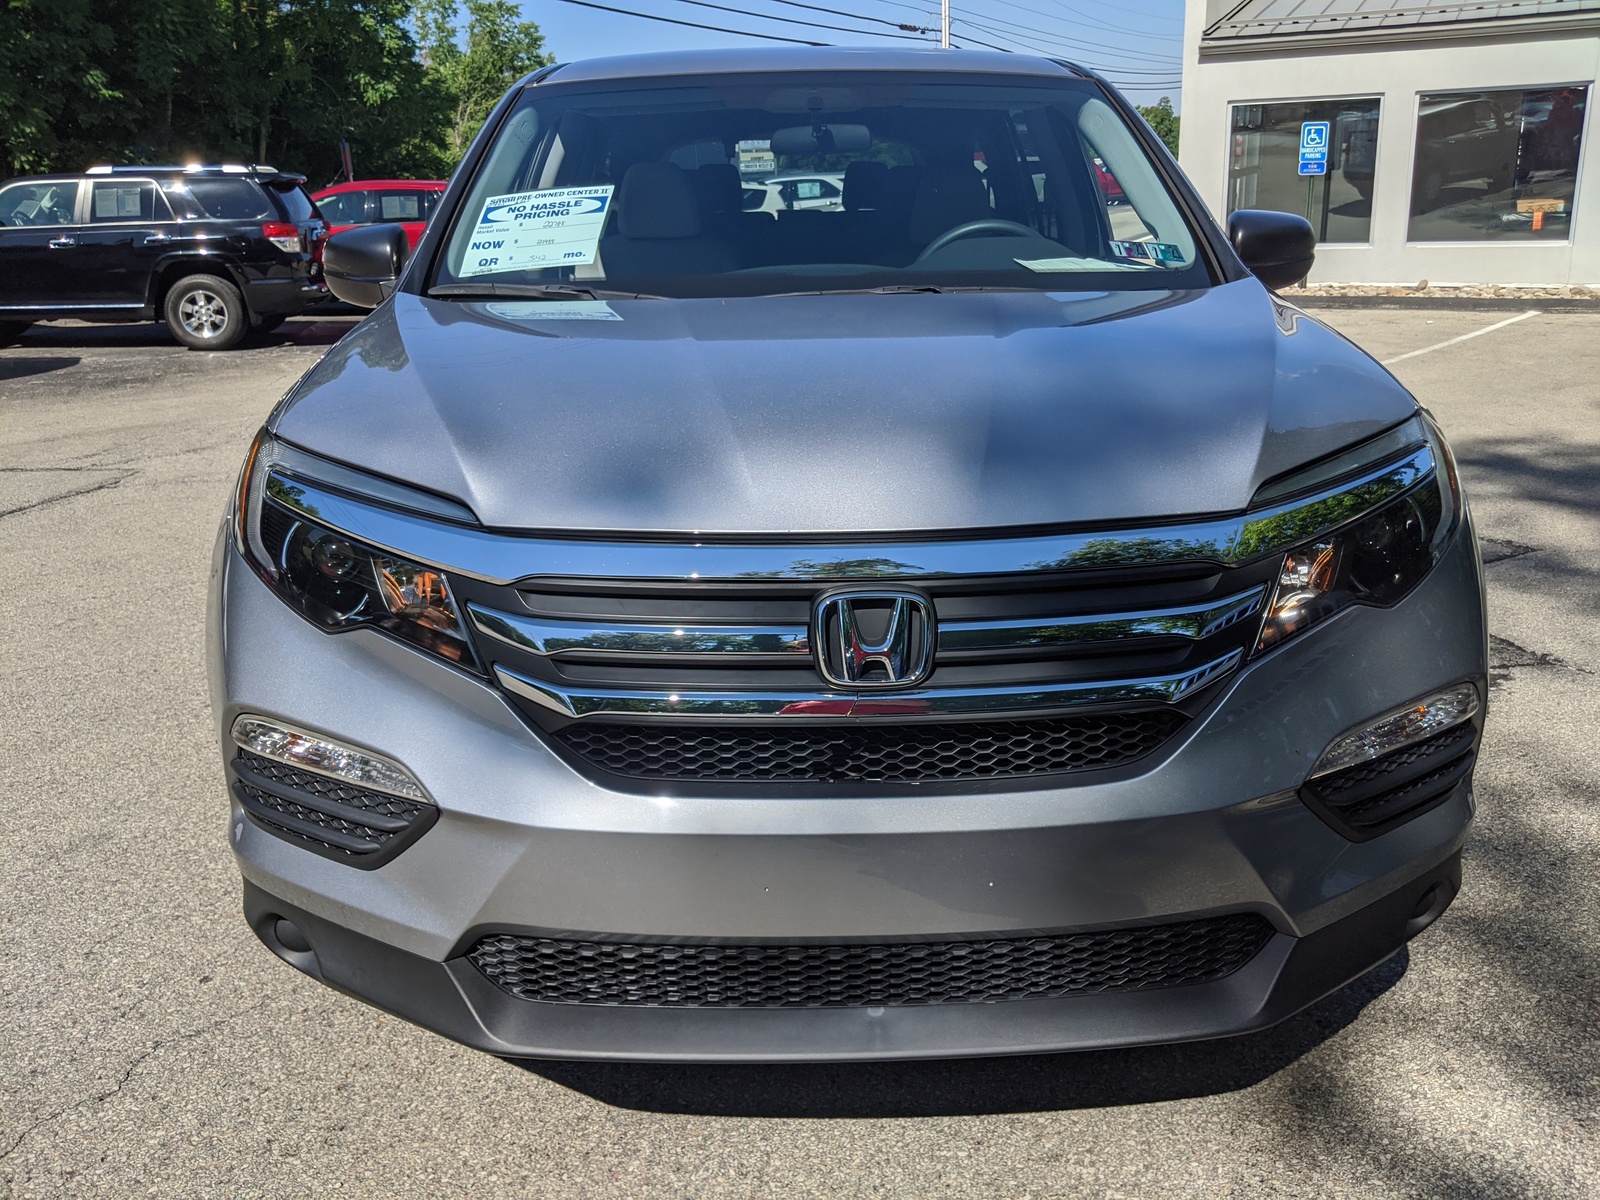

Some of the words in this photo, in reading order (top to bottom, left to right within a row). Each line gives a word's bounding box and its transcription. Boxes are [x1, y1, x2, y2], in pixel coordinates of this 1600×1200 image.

[516, 191, 565, 202] PRE-OWNED
[566, 189, 599, 197] CENTER
[507, 205, 526, 214] NO
[530, 199, 583, 211] HASSLE
[514, 208, 570, 220] PRICING
[471, 240, 505, 250] NOW
[562, 251, 586, 259] mo.
[478, 257, 499, 267] OR
